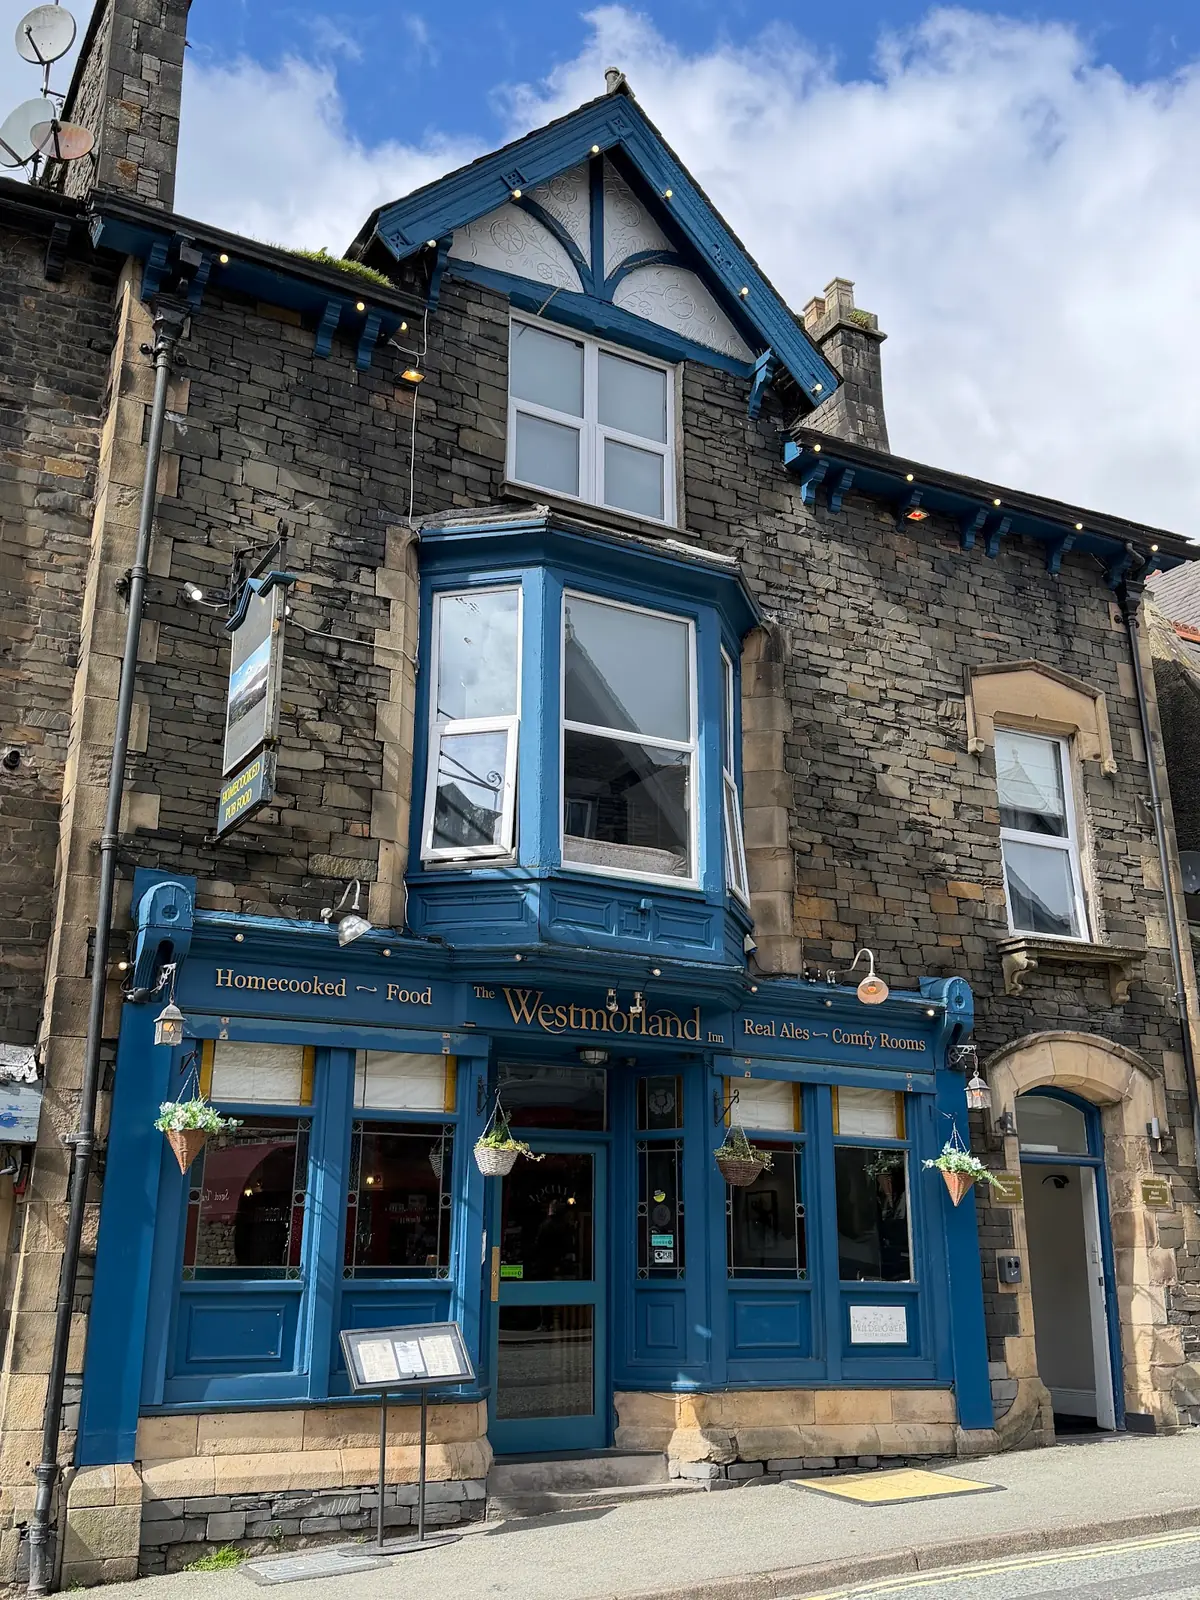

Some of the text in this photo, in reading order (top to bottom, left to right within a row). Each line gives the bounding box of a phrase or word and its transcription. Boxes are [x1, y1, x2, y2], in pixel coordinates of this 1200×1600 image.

[221, 761, 260, 806] HOMECOOKED
[224, 787, 253, 822] PUB FOOD
[215, 968, 347, 997] Homecooked
[386, 983, 433, 1006] Food
[473, 985, 725, 1044] The Westmorland Inn
[743, 1019, 776, 1037] Real
[779, 1022, 810, 1041] Ales
[832, 1028, 877, 1050] Comfy
[879, 1032, 926, 1051] Rooms
